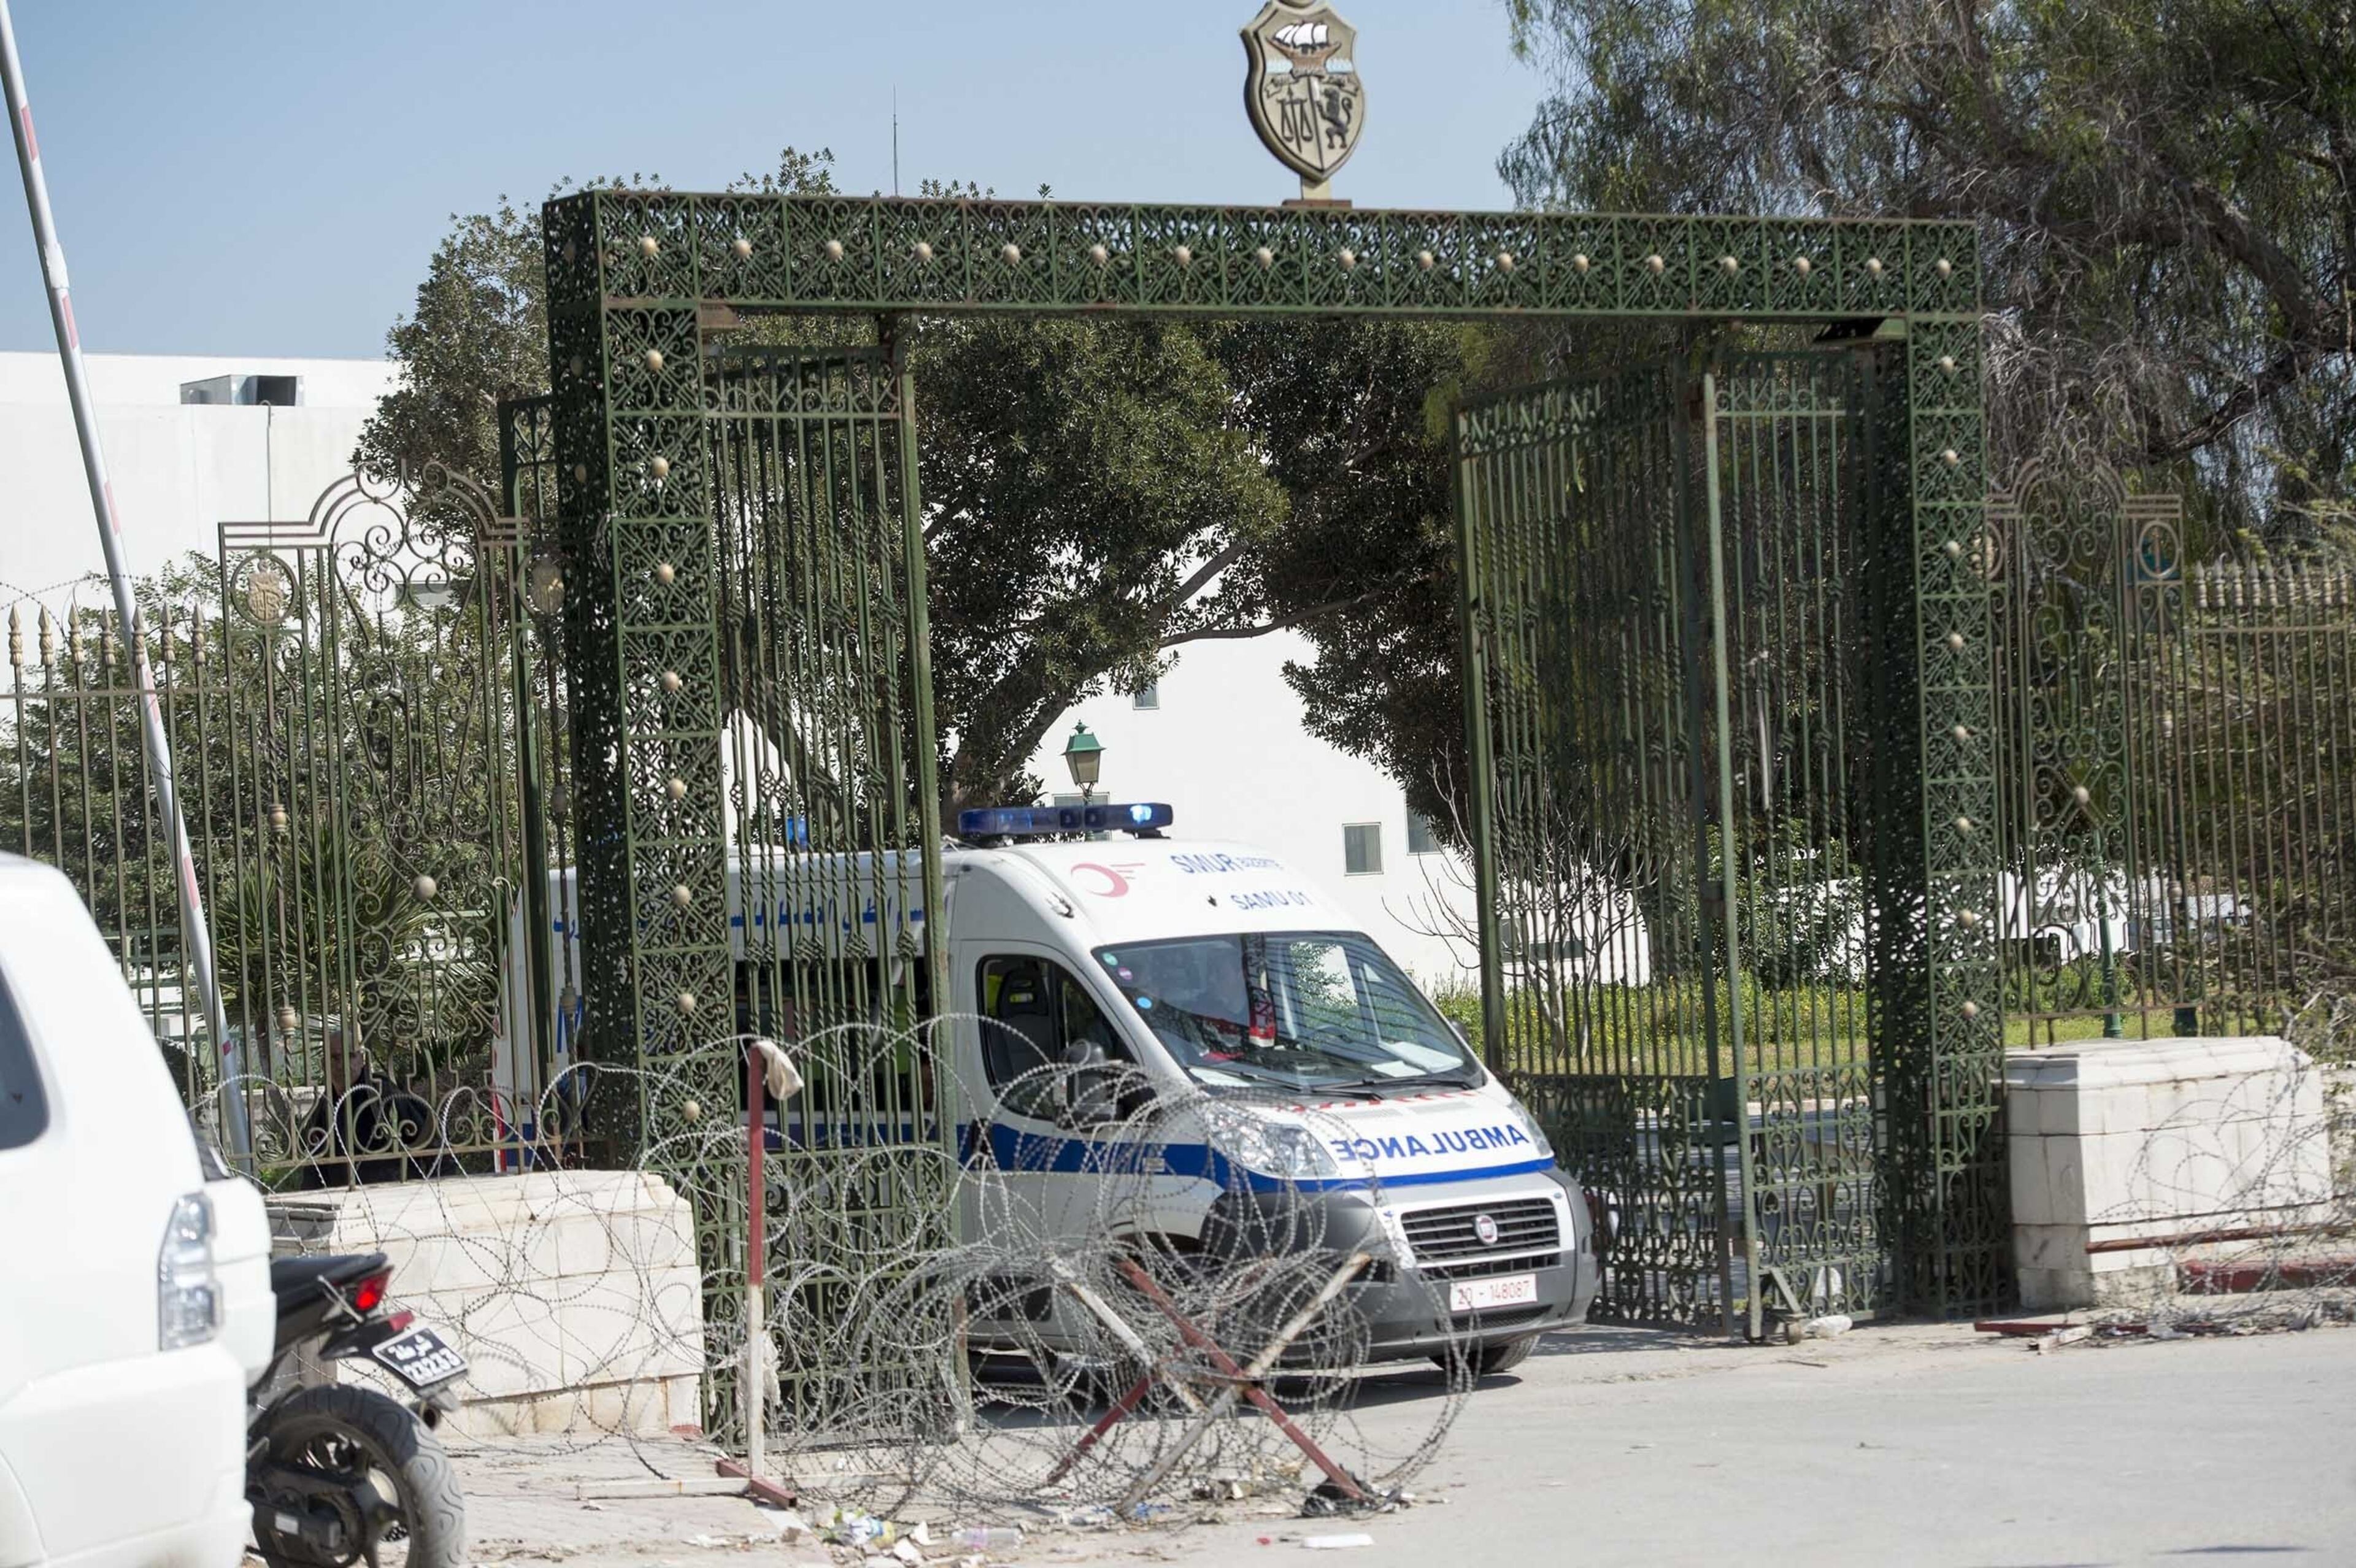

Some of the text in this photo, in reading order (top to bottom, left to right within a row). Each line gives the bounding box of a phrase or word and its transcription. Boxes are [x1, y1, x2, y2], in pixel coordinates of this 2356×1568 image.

[1170, 853, 1244, 874] SMUR
[1230, 890, 1313, 910] SAMU 01
